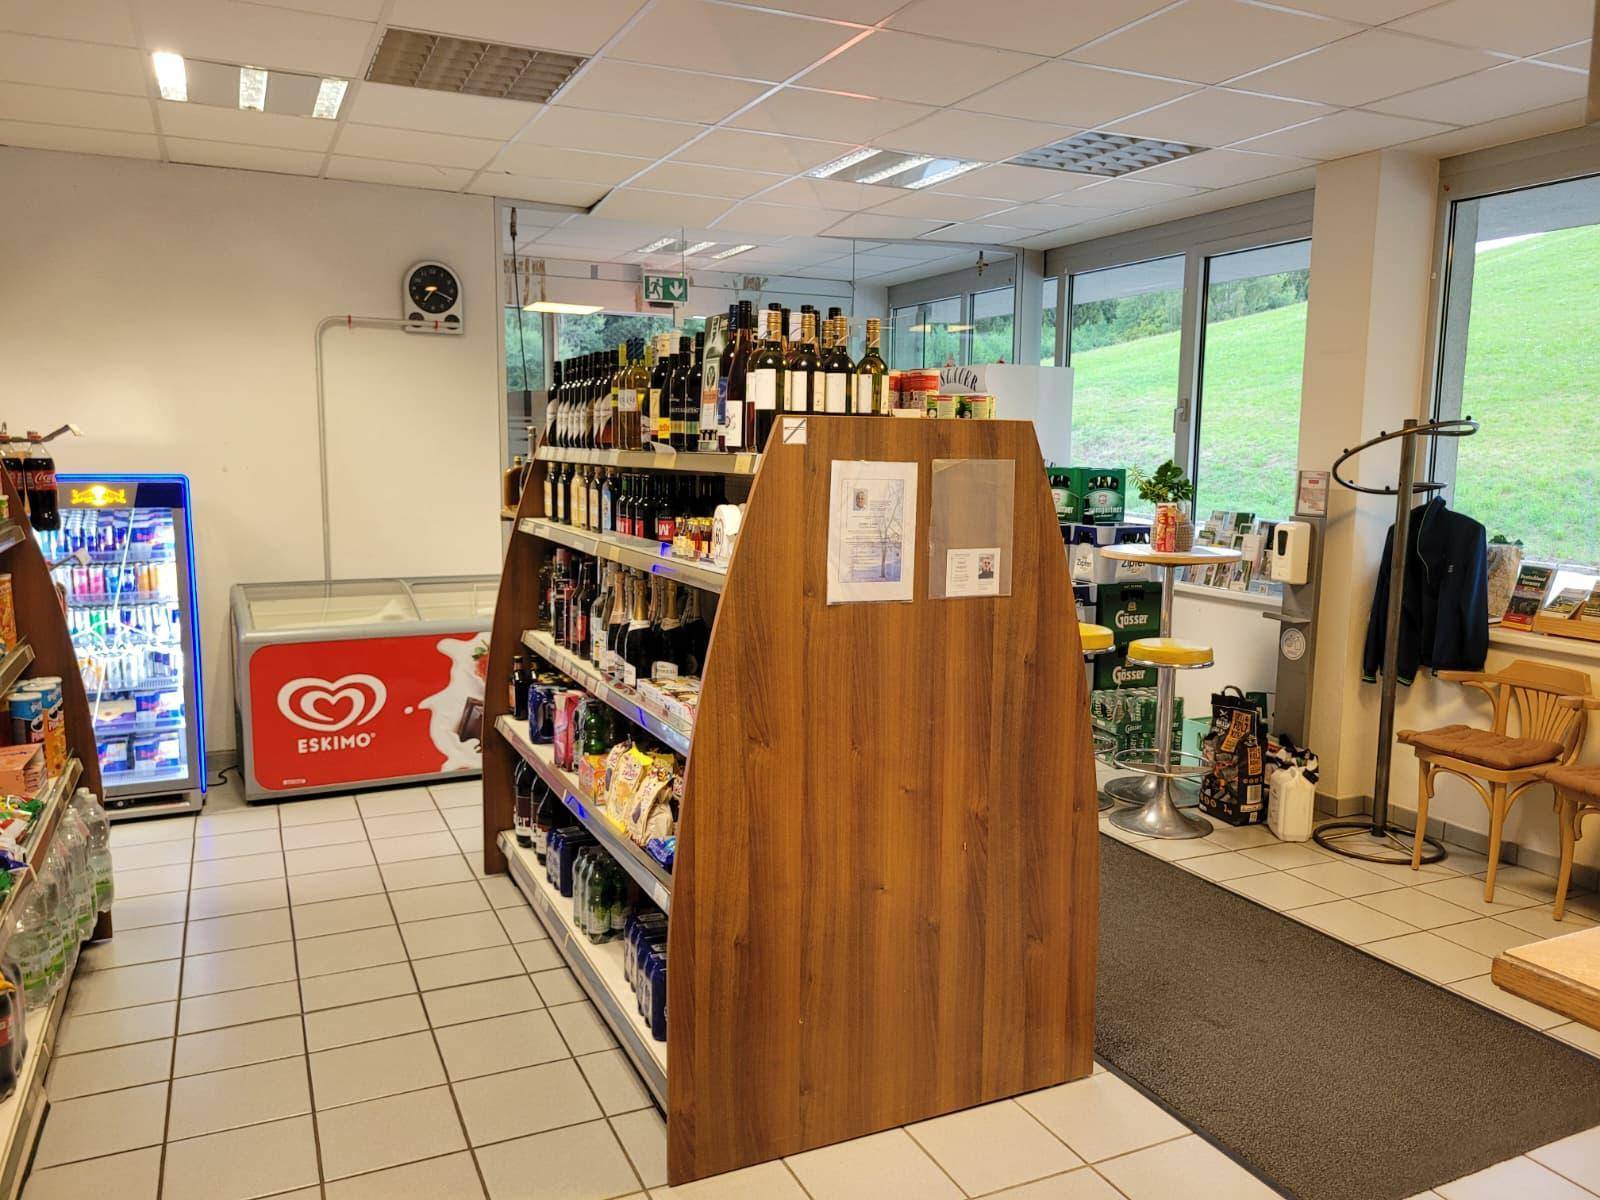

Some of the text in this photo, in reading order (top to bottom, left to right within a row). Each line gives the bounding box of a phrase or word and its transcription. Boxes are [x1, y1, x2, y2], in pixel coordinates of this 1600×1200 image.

[1115, 610, 1149, 628] Gösser
[1112, 666, 1146, 685] Gösser
[297, 732, 372, 754] ESKIMO
